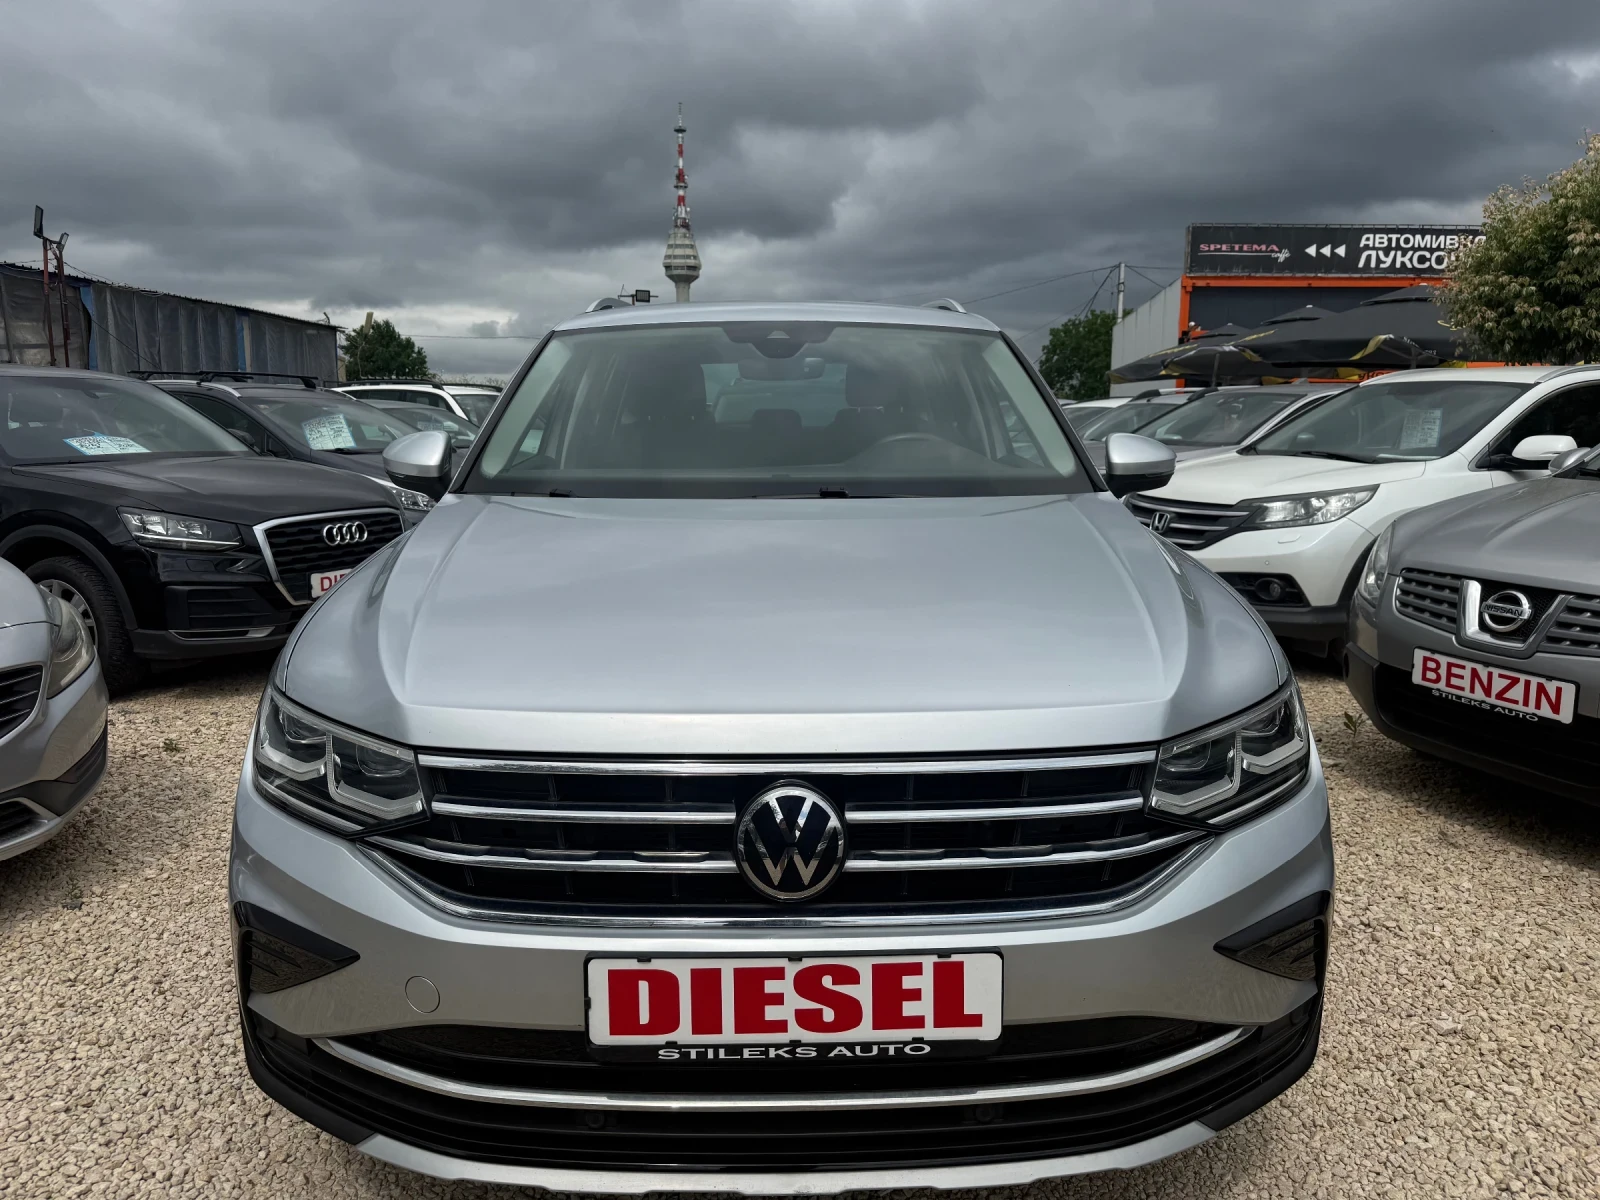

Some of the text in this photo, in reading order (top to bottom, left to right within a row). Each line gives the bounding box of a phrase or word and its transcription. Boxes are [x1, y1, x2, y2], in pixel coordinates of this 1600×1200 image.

[1199, 243, 1280, 251] SPETEMA
[1483, 603, 1523, 617] NISSAN
[1421, 655, 1562, 716] BENZIN
[1431, 689, 1539, 722] STILEKS AUTO
[607, 961, 983, 1036] DIESEL
[657, 1043, 931, 1060] STILEKS AUTO
